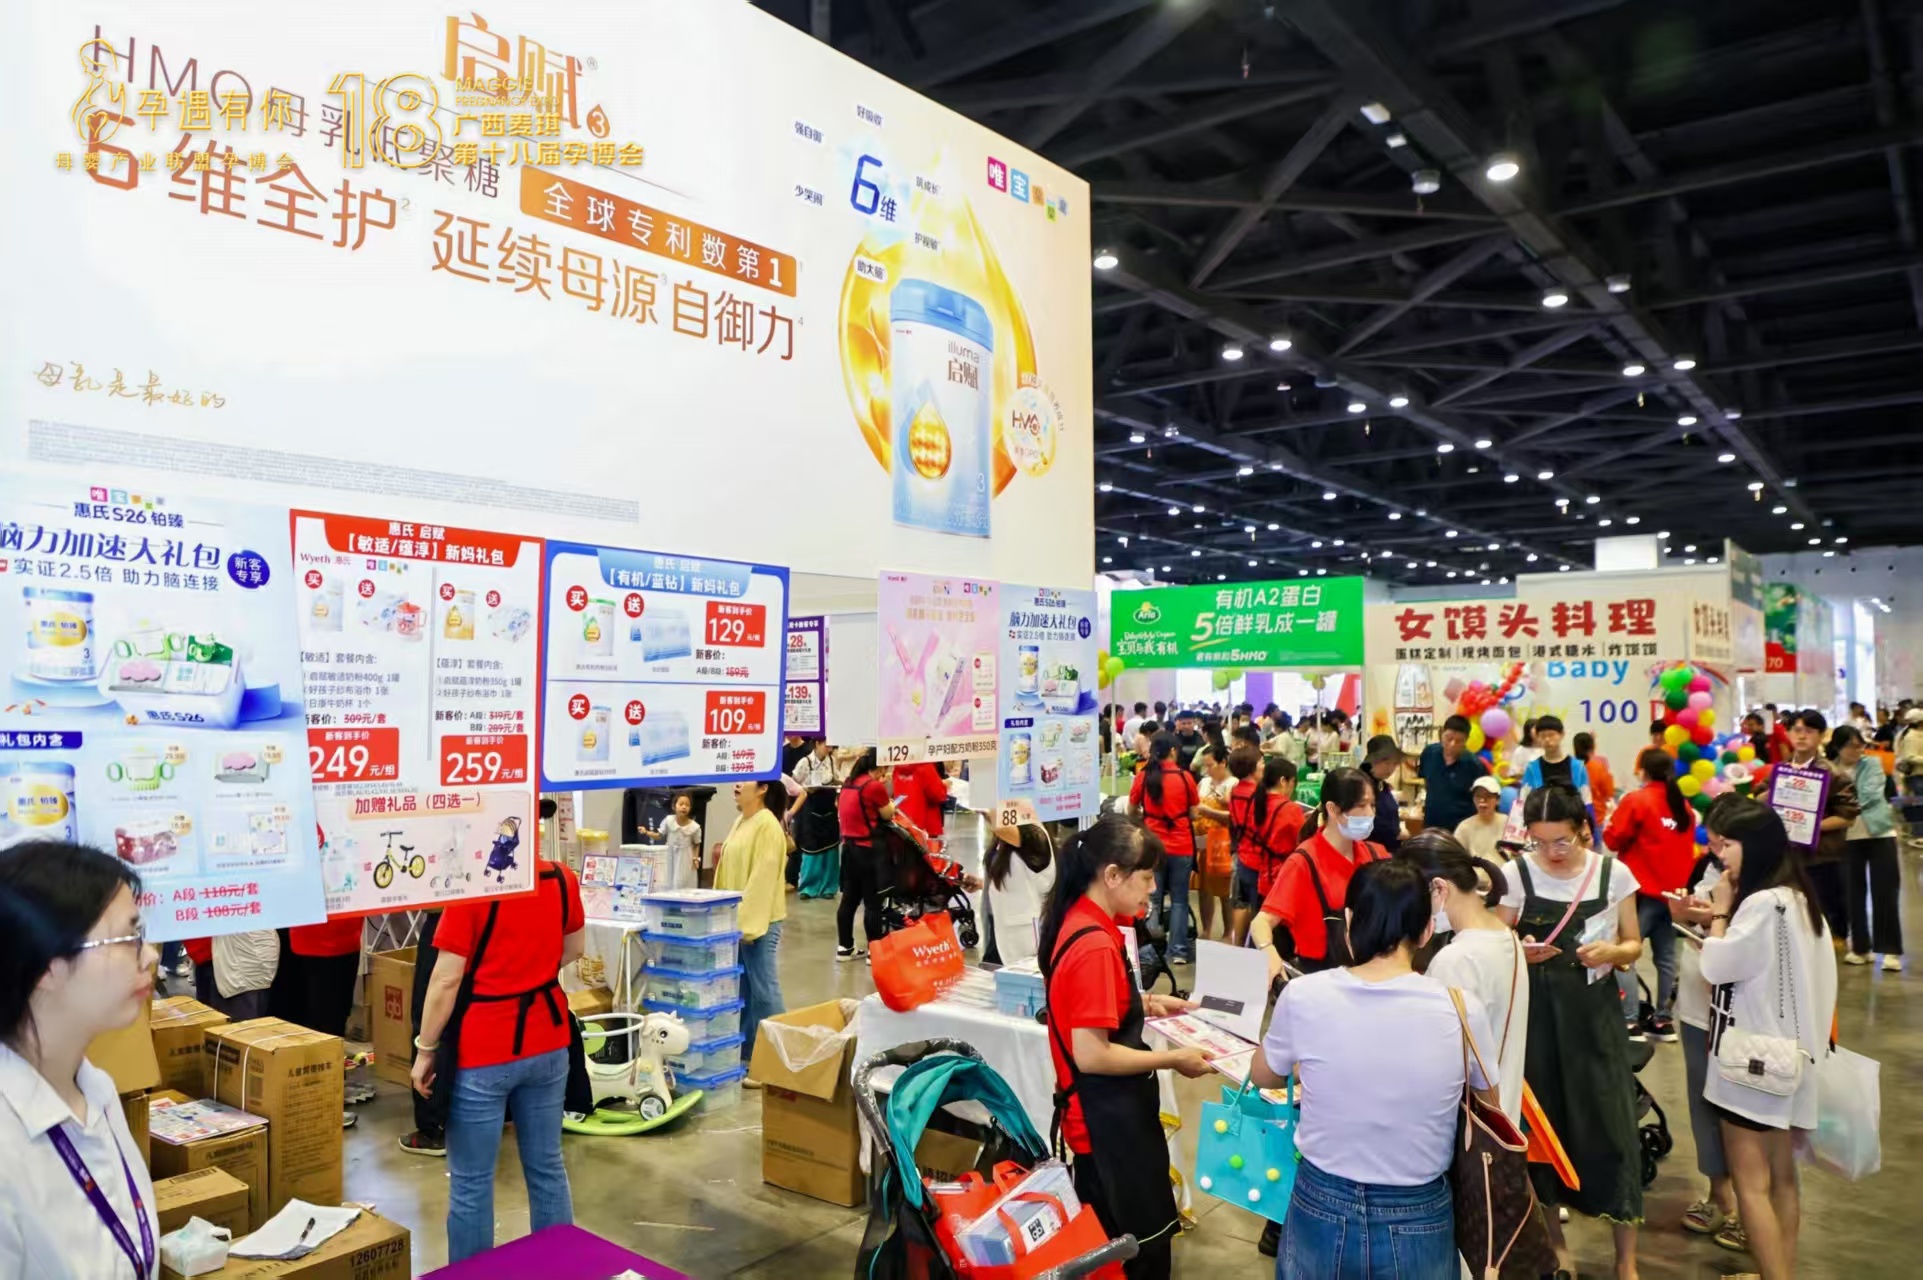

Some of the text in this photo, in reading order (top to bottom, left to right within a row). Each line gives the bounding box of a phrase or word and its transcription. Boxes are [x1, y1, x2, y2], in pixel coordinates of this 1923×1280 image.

[300, 551, 331, 565] Wyeth
[308, 573, 320, 587] 买
[361, 582, 373, 596] 送
[442, 585, 453, 598] 买
[488, 593, 499, 605] 送
[570, 591, 584, 606] 买
[628, 597, 641, 612] 送
[1216, 585, 1321, 610] 有机A2蛋白
[1395, 599, 1657, 642] 女馍头料理
[709, 617, 745, 643] 129
[790, 635, 803, 648] 28
[789, 686, 808, 699] 139
[572, 699, 586, 715] 买
[628, 704, 642, 719] 送
[1580, 700, 1638, 723] 100
[710, 708, 746, 732] 109
[888, 745, 909, 761] 129
[446, 752, 502, 783] 259
[1002, 809, 1017, 826] 88
[912, 941, 950, 958] Wyeth
